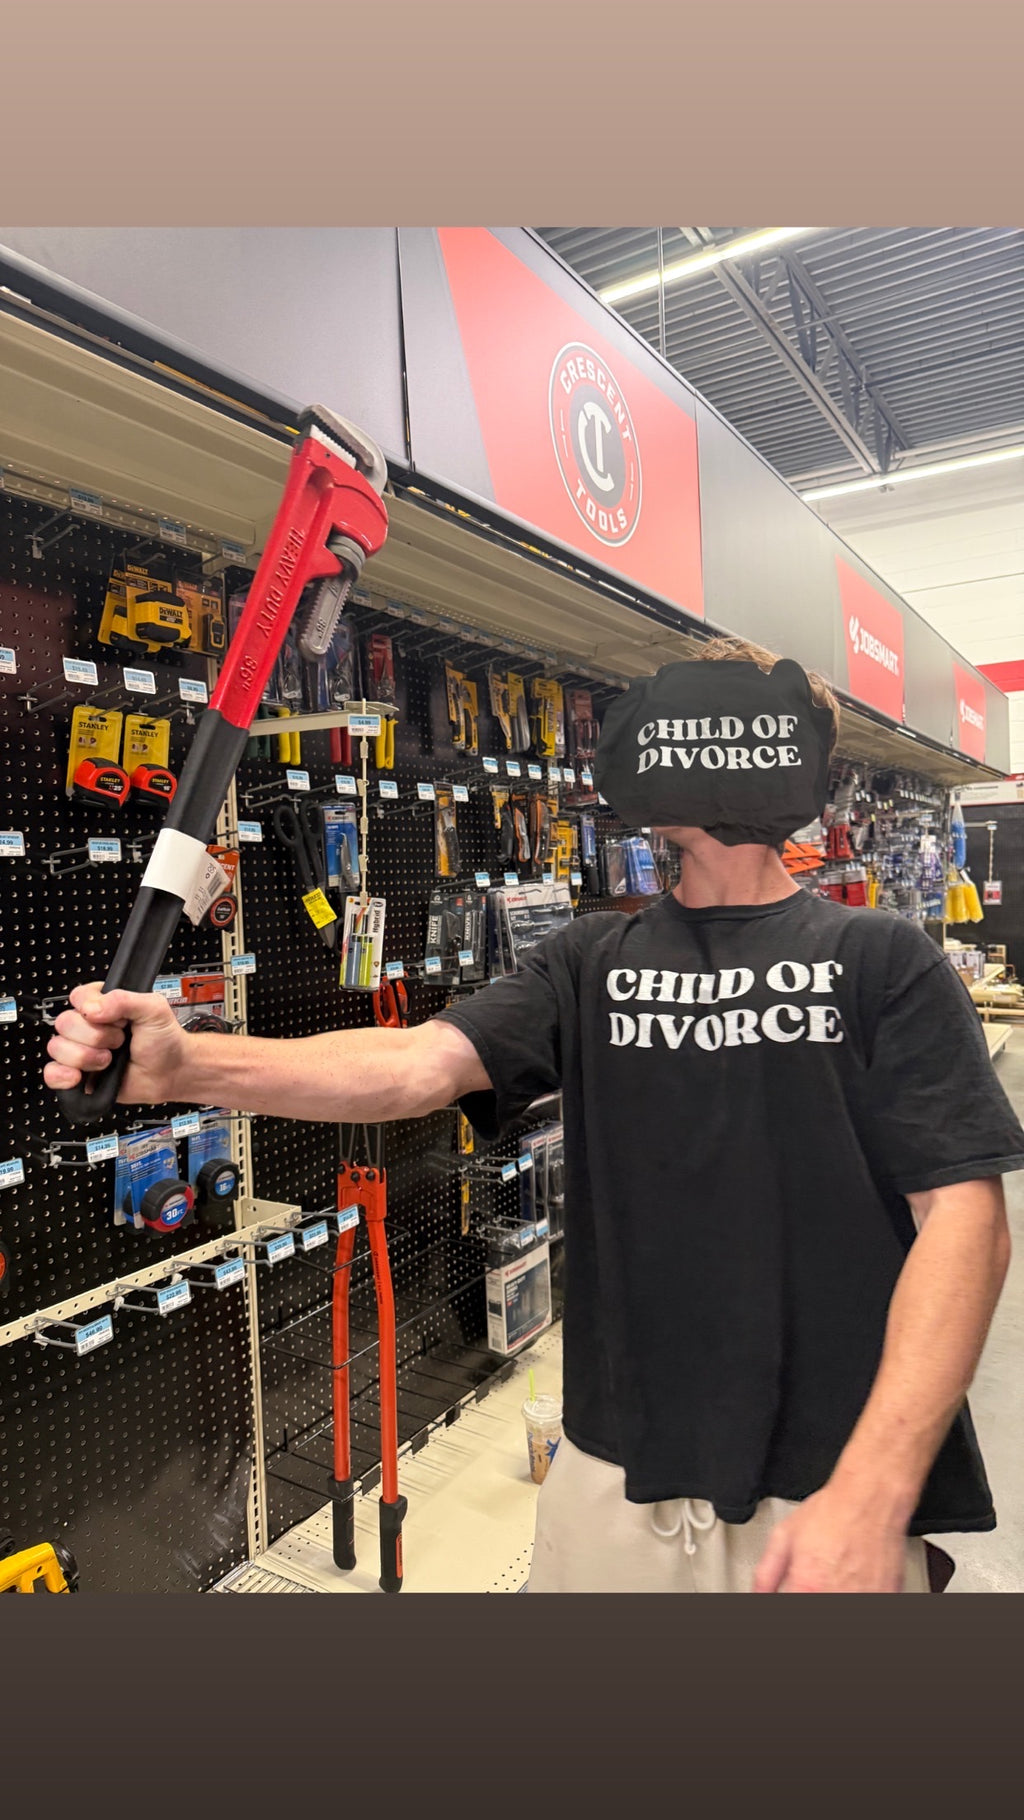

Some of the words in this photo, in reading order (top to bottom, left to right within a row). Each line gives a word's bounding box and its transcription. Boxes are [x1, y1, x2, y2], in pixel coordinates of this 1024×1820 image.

[560, 357, 632, 441] CRESCENT
[576, 479, 627, 533] TOOLS
[281, 526, 305, 584] HEAVY
[257, 584, 284, 638] DUTY
[860, 628, 899, 676] JOBSMART
[79, 722, 109, 731] STANLEY
[131, 729, 158, 738] STANLEY
[637, 716, 744, 746] CHILD
[752, 714, 798, 739] OF
[636, 745, 802, 774] DIVORCE
[372, 910, 381, 933] Hybrid
[430, 915, 439, 944] KNIFE
[606, 967, 755, 1004] CHILD
[766, 960, 843, 993] OF
[608, 1004, 844, 1051] DIVORCE
